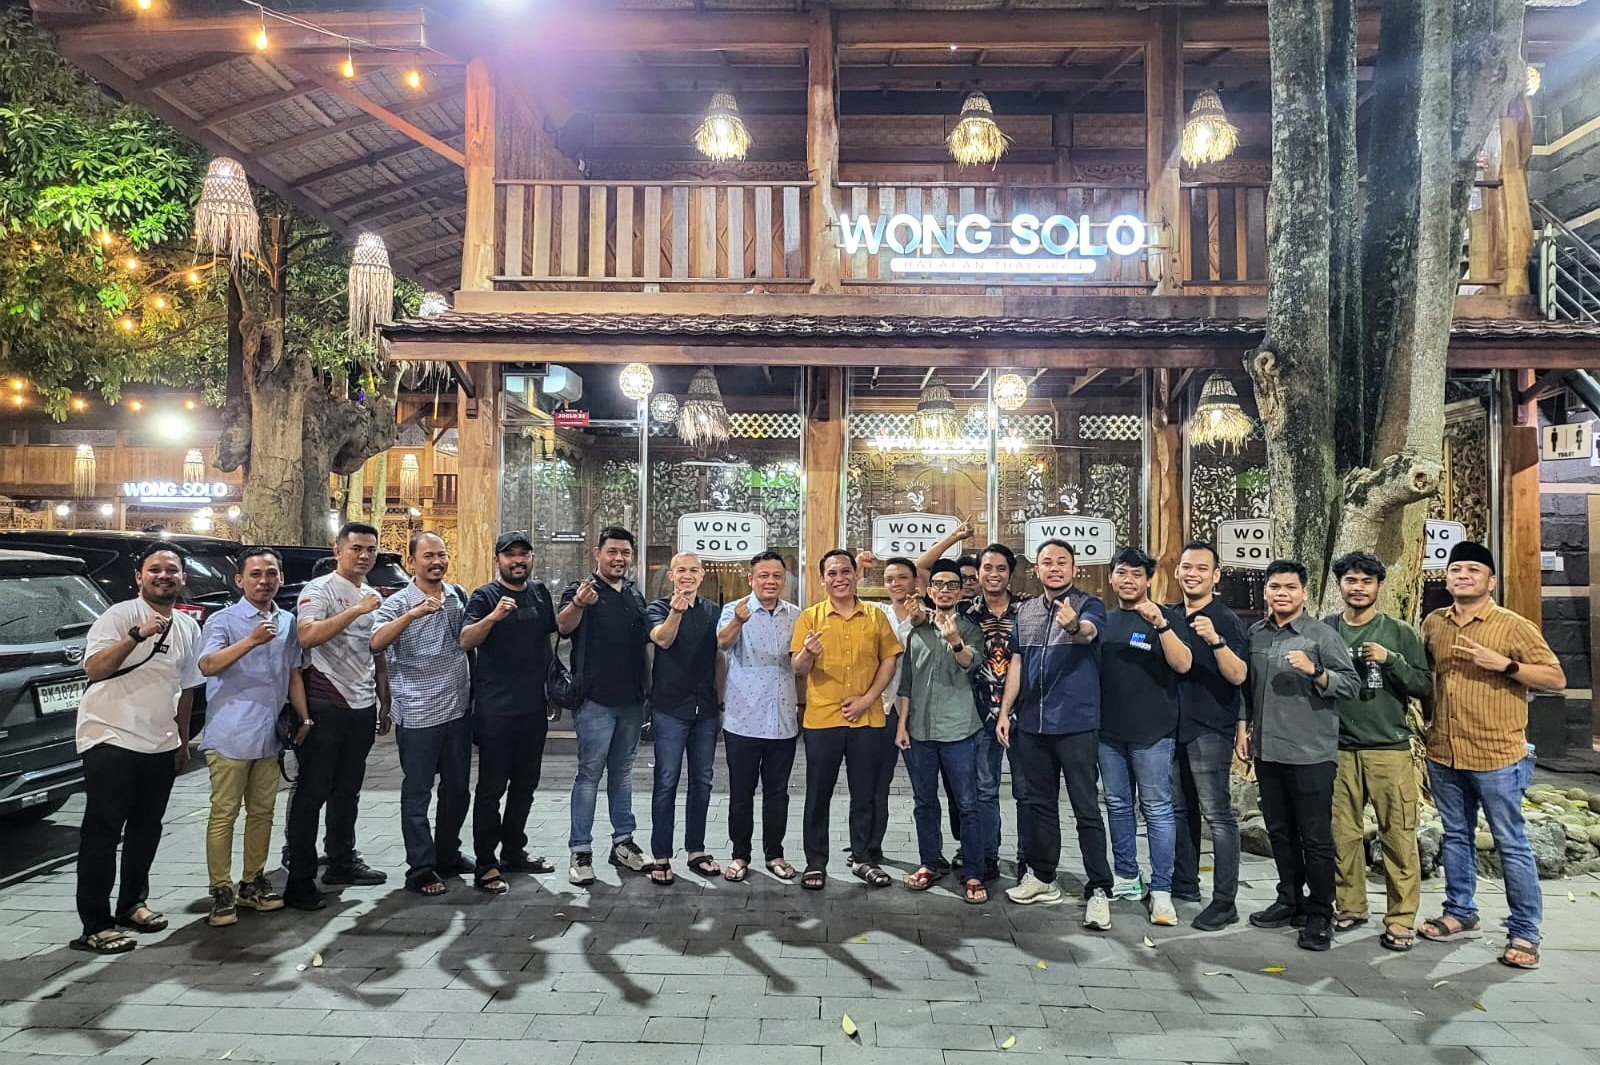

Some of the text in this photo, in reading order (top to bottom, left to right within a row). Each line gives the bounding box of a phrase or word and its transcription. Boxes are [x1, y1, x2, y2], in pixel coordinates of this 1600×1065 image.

[840, 214, 1146, 255] WONG SOLO
[124, 481, 228, 497] WONG SOLO
[694, 521, 751, 532] WONG
[889, 523, 946, 534] WONG
[1041, 525, 1099, 536] WONG
[1234, 528, 1270, 540] WO
[696, 540, 748, 551] SOLO
